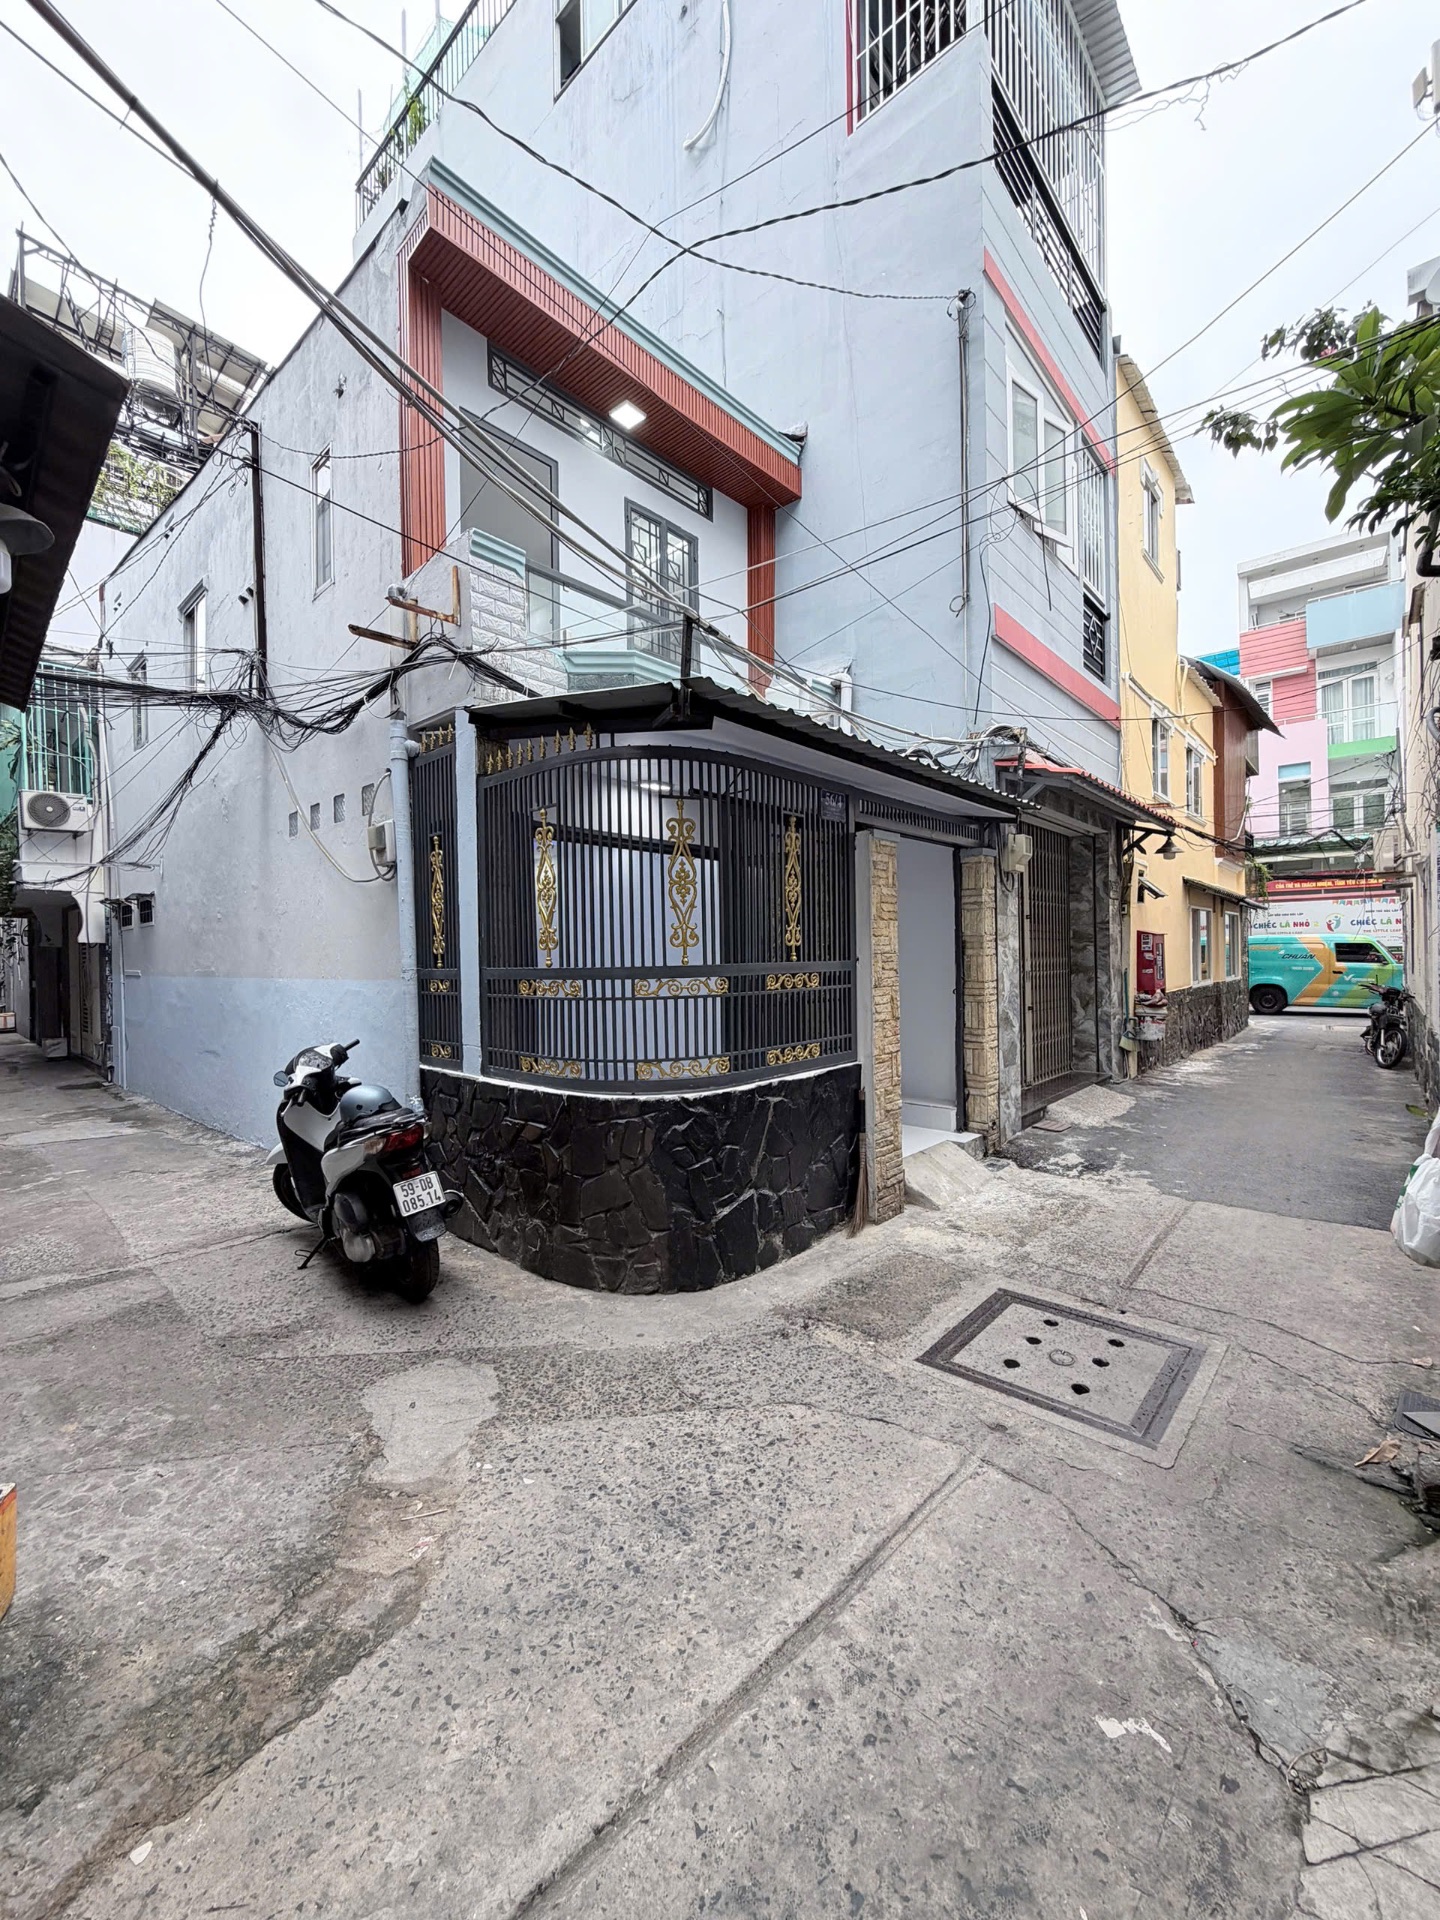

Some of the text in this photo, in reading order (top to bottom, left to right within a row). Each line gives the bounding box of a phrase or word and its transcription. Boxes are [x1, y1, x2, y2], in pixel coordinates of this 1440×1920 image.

[1253, 919, 1277, 930] CHIẾC
[1293, 918, 1310, 928] NHỎ
[1350, 916, 1377, 926] CHIẾC
[402, 1189, 441, 1213] 085.14
